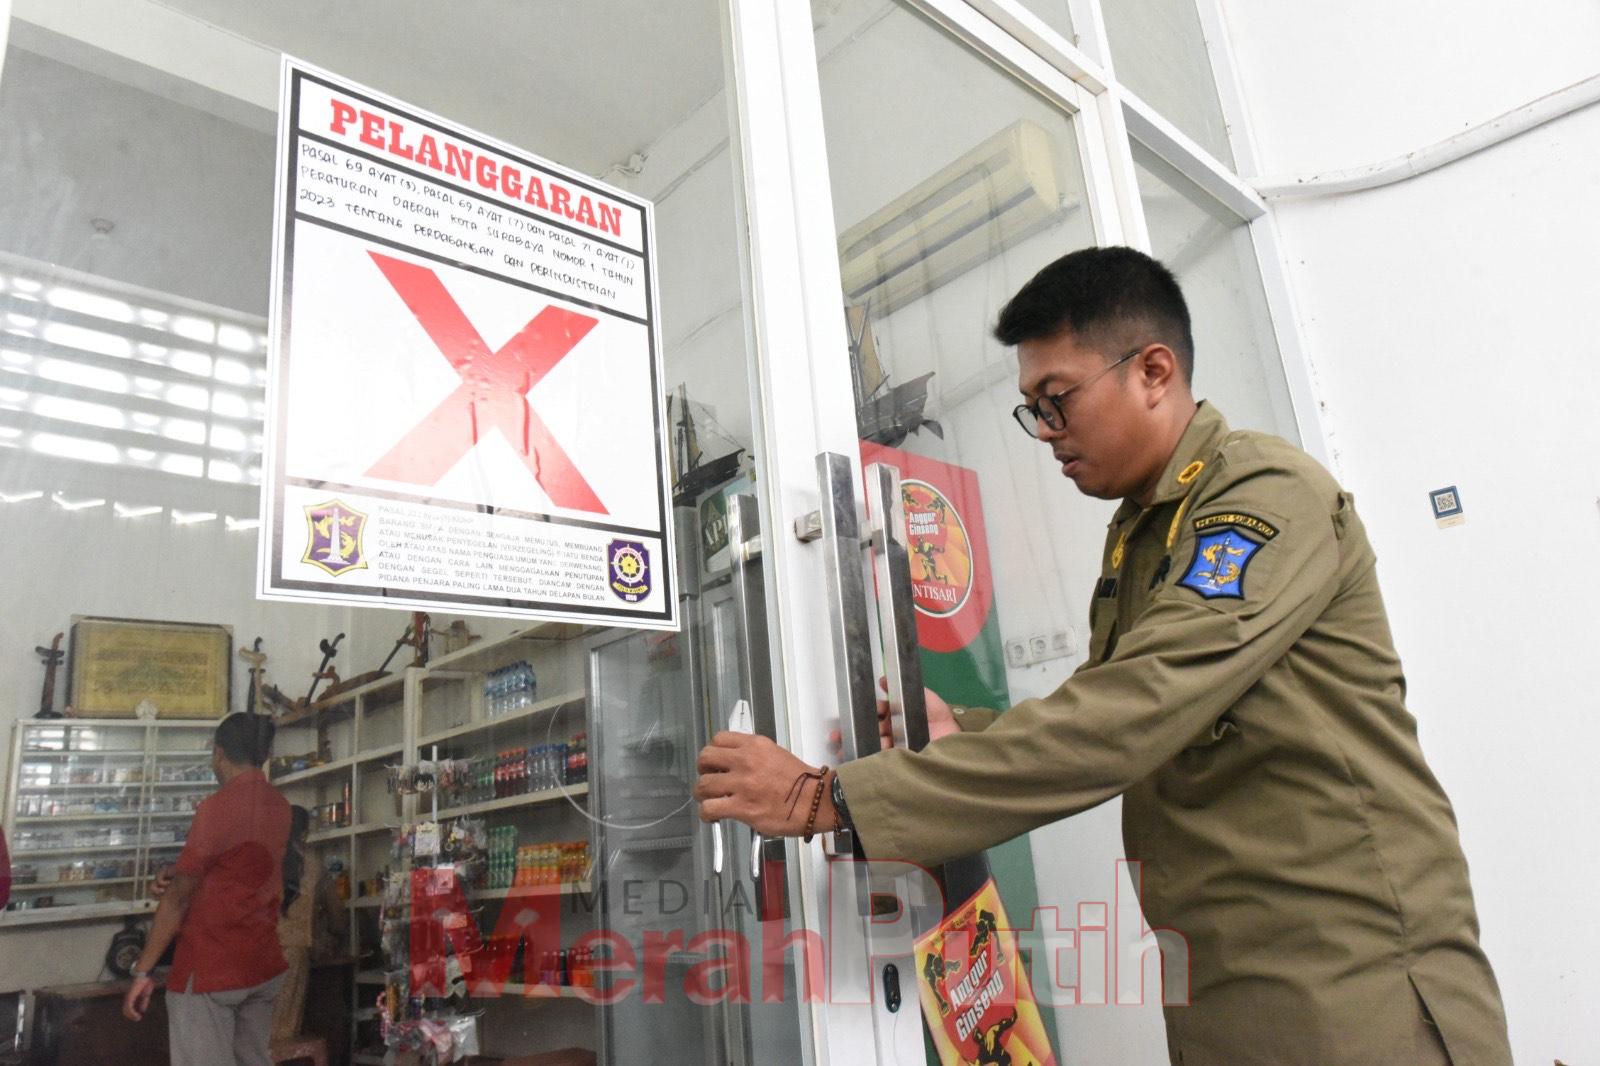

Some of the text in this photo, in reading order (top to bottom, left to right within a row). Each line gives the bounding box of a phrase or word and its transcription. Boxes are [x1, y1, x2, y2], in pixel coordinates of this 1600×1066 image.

[330, 98, 621, 237] PELANGGARAN
[302, 143, 338, 166] PASAL
[345, 158, 363, 172] 69
[368, 167, 397, 185] AYAT
[423, 186, 454, 205] PASAL
[458, 199, 473, 212] 69
[477, 206, 502, 224] AYAT
[527, 223, 545, 236] DAN
[548, 231, 576, 247] PASAL
[301, 164, 378, 198] PERATURAN
[392, 195, 439, 219] DAERAH
[450, 214, 477, 231] KOTA
[487, 226, 544, 255] SURABAYA
[552, 248, 586, 268] NOMOR
[602, 267, 633, 286] TAHUN
[300, 188, 616, 300] 2023 TENTANG PERDAGANGAN DAN PERINDUSTRIAN
[378, 517, 415, 529] BARANG
[448, 526, 481, 536] DENGAN
[564, 541, 603, 553] MEMBUANG
[909, 512, 936, 525] Anggur
[909, 524, 939, 536] Ginseng
[378, 528, 401, 538] ATAU
[447, 536, 498, 549] PENYEGELAN
[580, 554, 604, 563] BENDA
[378, 539, 402, 548] OLEH
[404, 542, 425, 551] ATAU
[427, 546, 447, 554] ATAS
[448, 548, 471, 557] NAMA
[473, 551, 514, 562] PENGUASA
[515, 556, 538, 565] UMUM
[378, 551, 605, 582] ATAU DENGAN CARA LAIN MENGGAGALKAN PENUTUPAN
[378, 561, 415, 572] DENGAN
[421, 566, 449, 576] SEGEL
[454, 570, 488, 581] SEPERTI
[539, 578, 572, 589] DIANCAM
[576, 583, 605, 592] DENGAN
[378, 573, 605, 602] PIDANA PENJARA PALING LAMA DUA TAHUN DELAPAN BULAN
[913, 583, 957, 604] NTISARI
[949, 950, 988, 1013] Anggur
[955, 969, 1004, 1042] Ginseng
